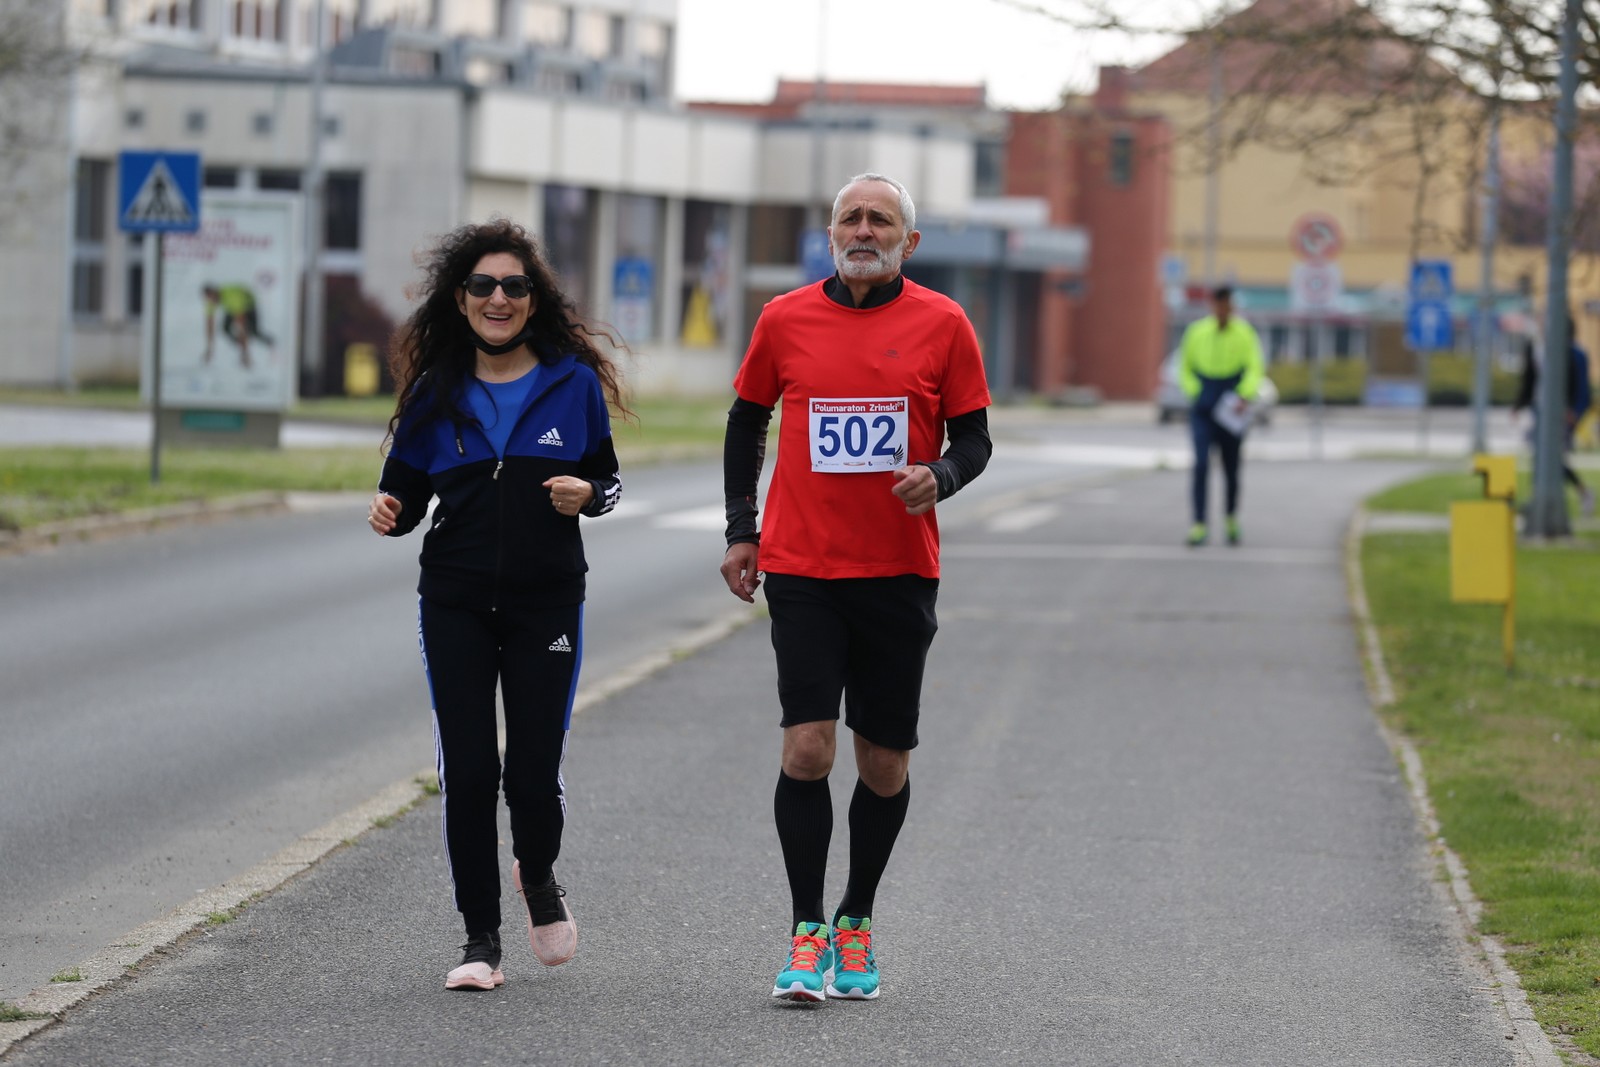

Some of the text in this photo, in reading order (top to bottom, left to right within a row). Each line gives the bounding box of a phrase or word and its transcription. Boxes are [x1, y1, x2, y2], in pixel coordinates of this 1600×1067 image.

[814, 404, 866, 412] Polumaraton
[869, 402, 898, 412] Zrinski
[818, 415, 896, 457] 502
[537, 438, 563, 447] adidas
[548, 644, 572, 652] adidas
